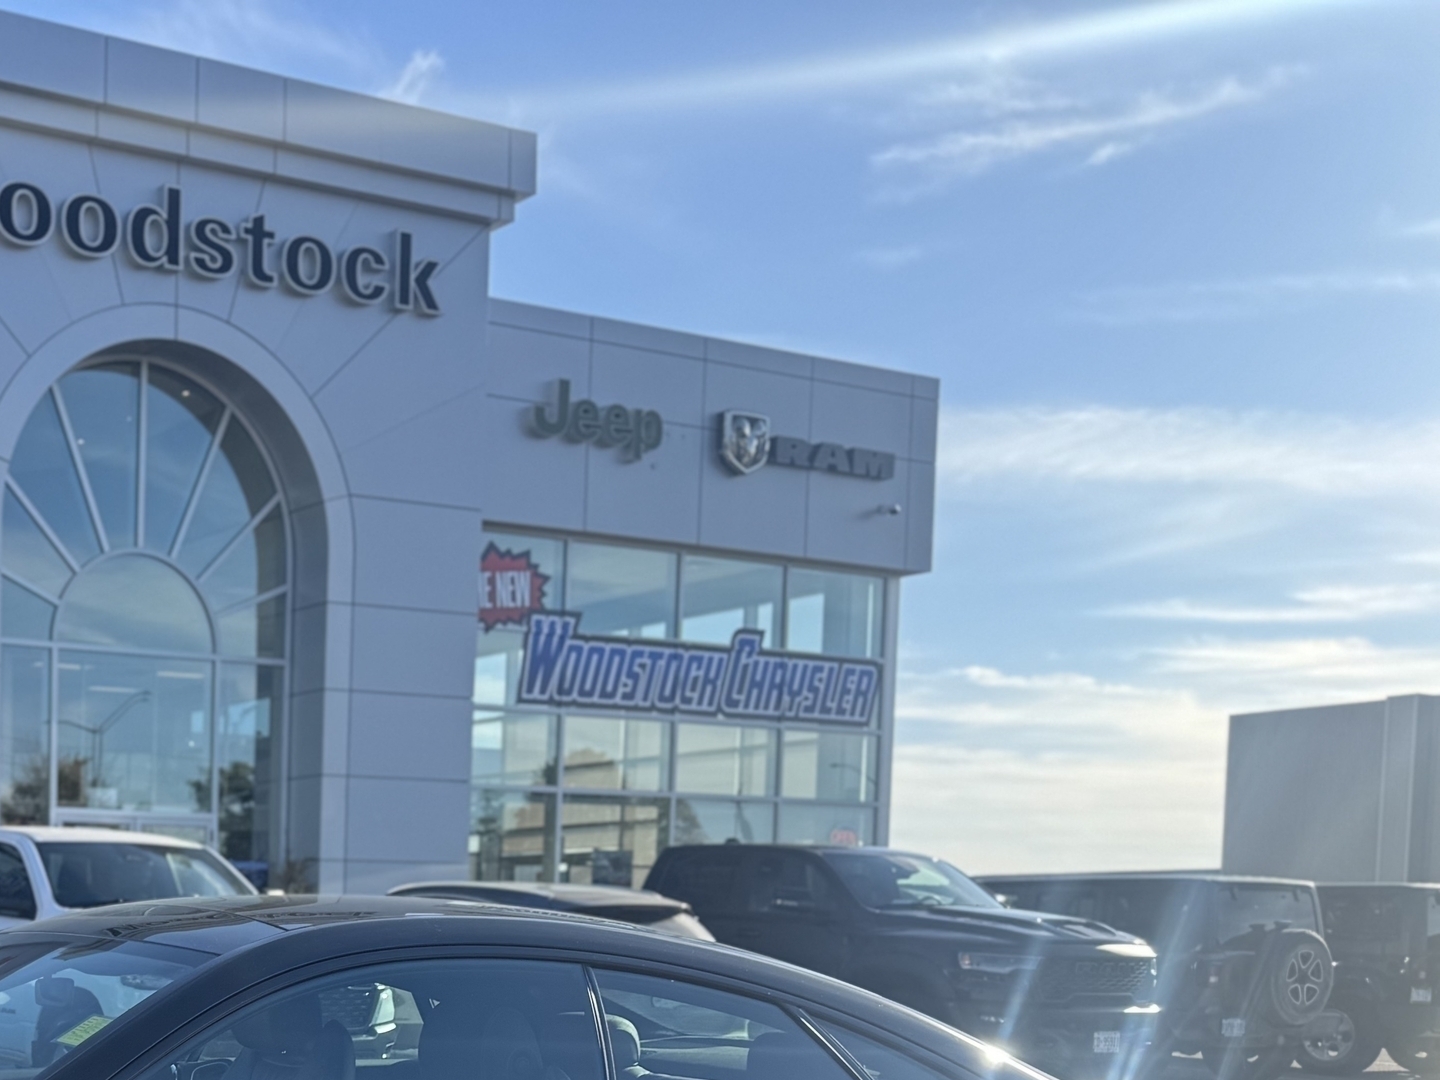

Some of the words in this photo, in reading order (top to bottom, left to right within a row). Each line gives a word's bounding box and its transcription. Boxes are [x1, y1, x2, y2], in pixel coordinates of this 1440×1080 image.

[524, 378, 663, 464] Jeep
[768, 435, 896, 481] RAM
[495, 571, 531, 608] NEW
